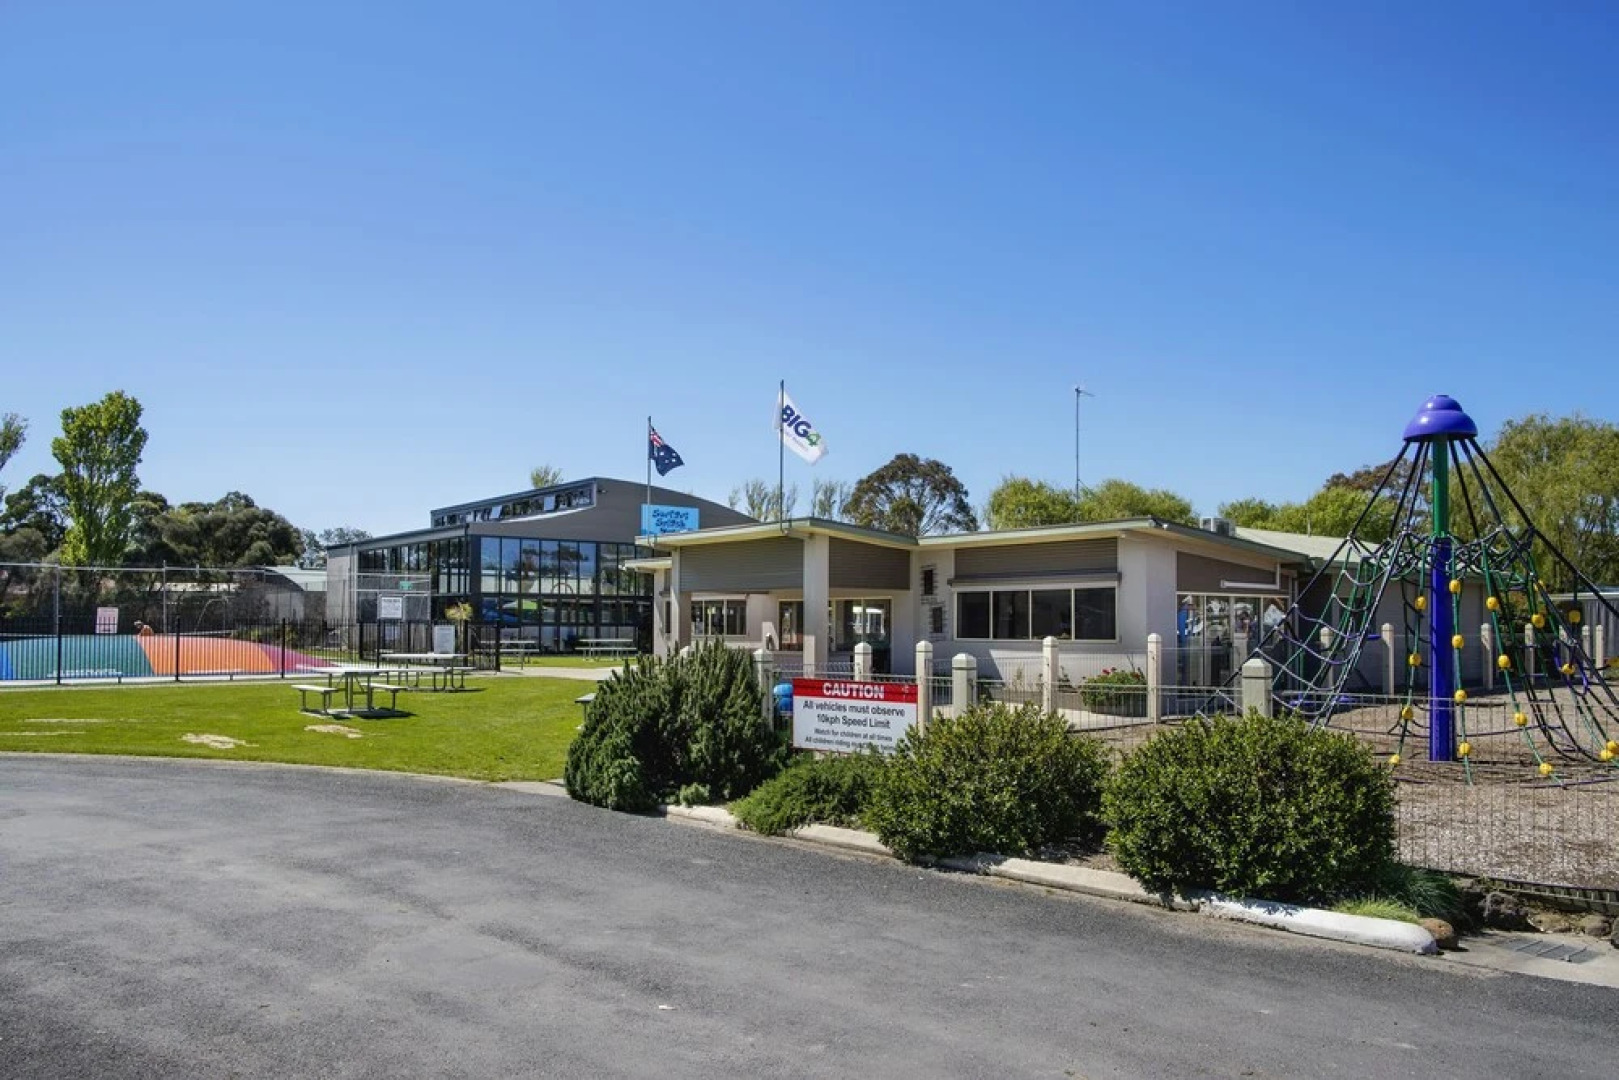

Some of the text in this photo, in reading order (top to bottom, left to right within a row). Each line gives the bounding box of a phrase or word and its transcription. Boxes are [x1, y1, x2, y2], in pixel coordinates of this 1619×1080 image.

[823, 682, 885, 699] CAUTION
[803, 700, 906, 717] All vehicles must observe
[817, 713, 891, 729] 10kph Speed Limit
[840, 730, 862, 738] children
